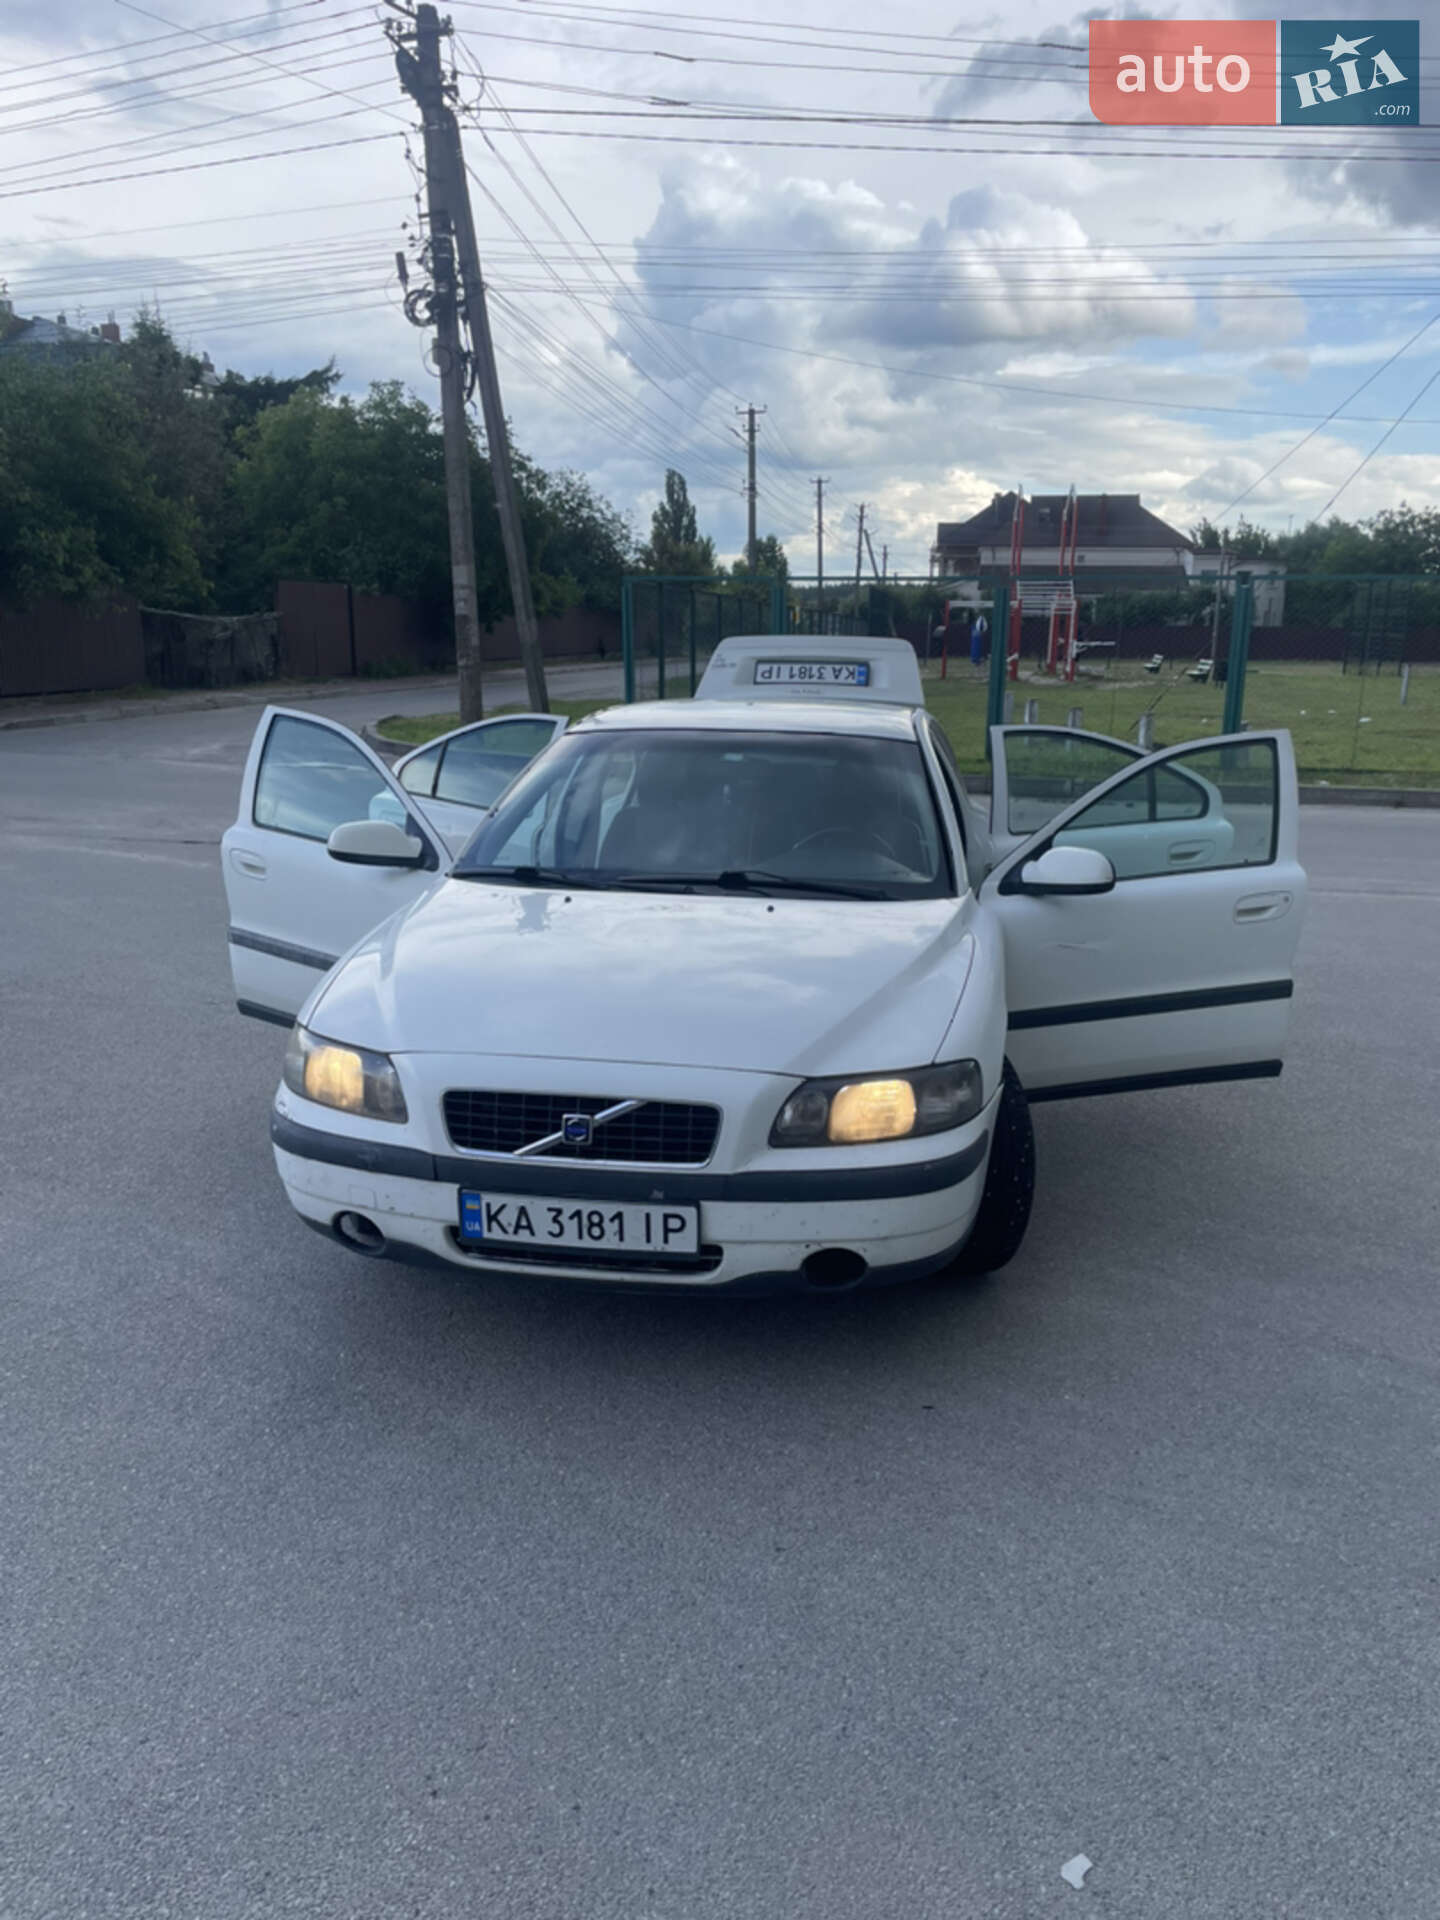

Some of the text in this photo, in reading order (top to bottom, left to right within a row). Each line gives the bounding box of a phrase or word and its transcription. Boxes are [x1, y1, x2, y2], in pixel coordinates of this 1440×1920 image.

[760, 665, 856, 680] KA 3181 IP
[465, 1221, 481, 1232] UA
[485, 1201, 688, 1245] KA 3181 IP
